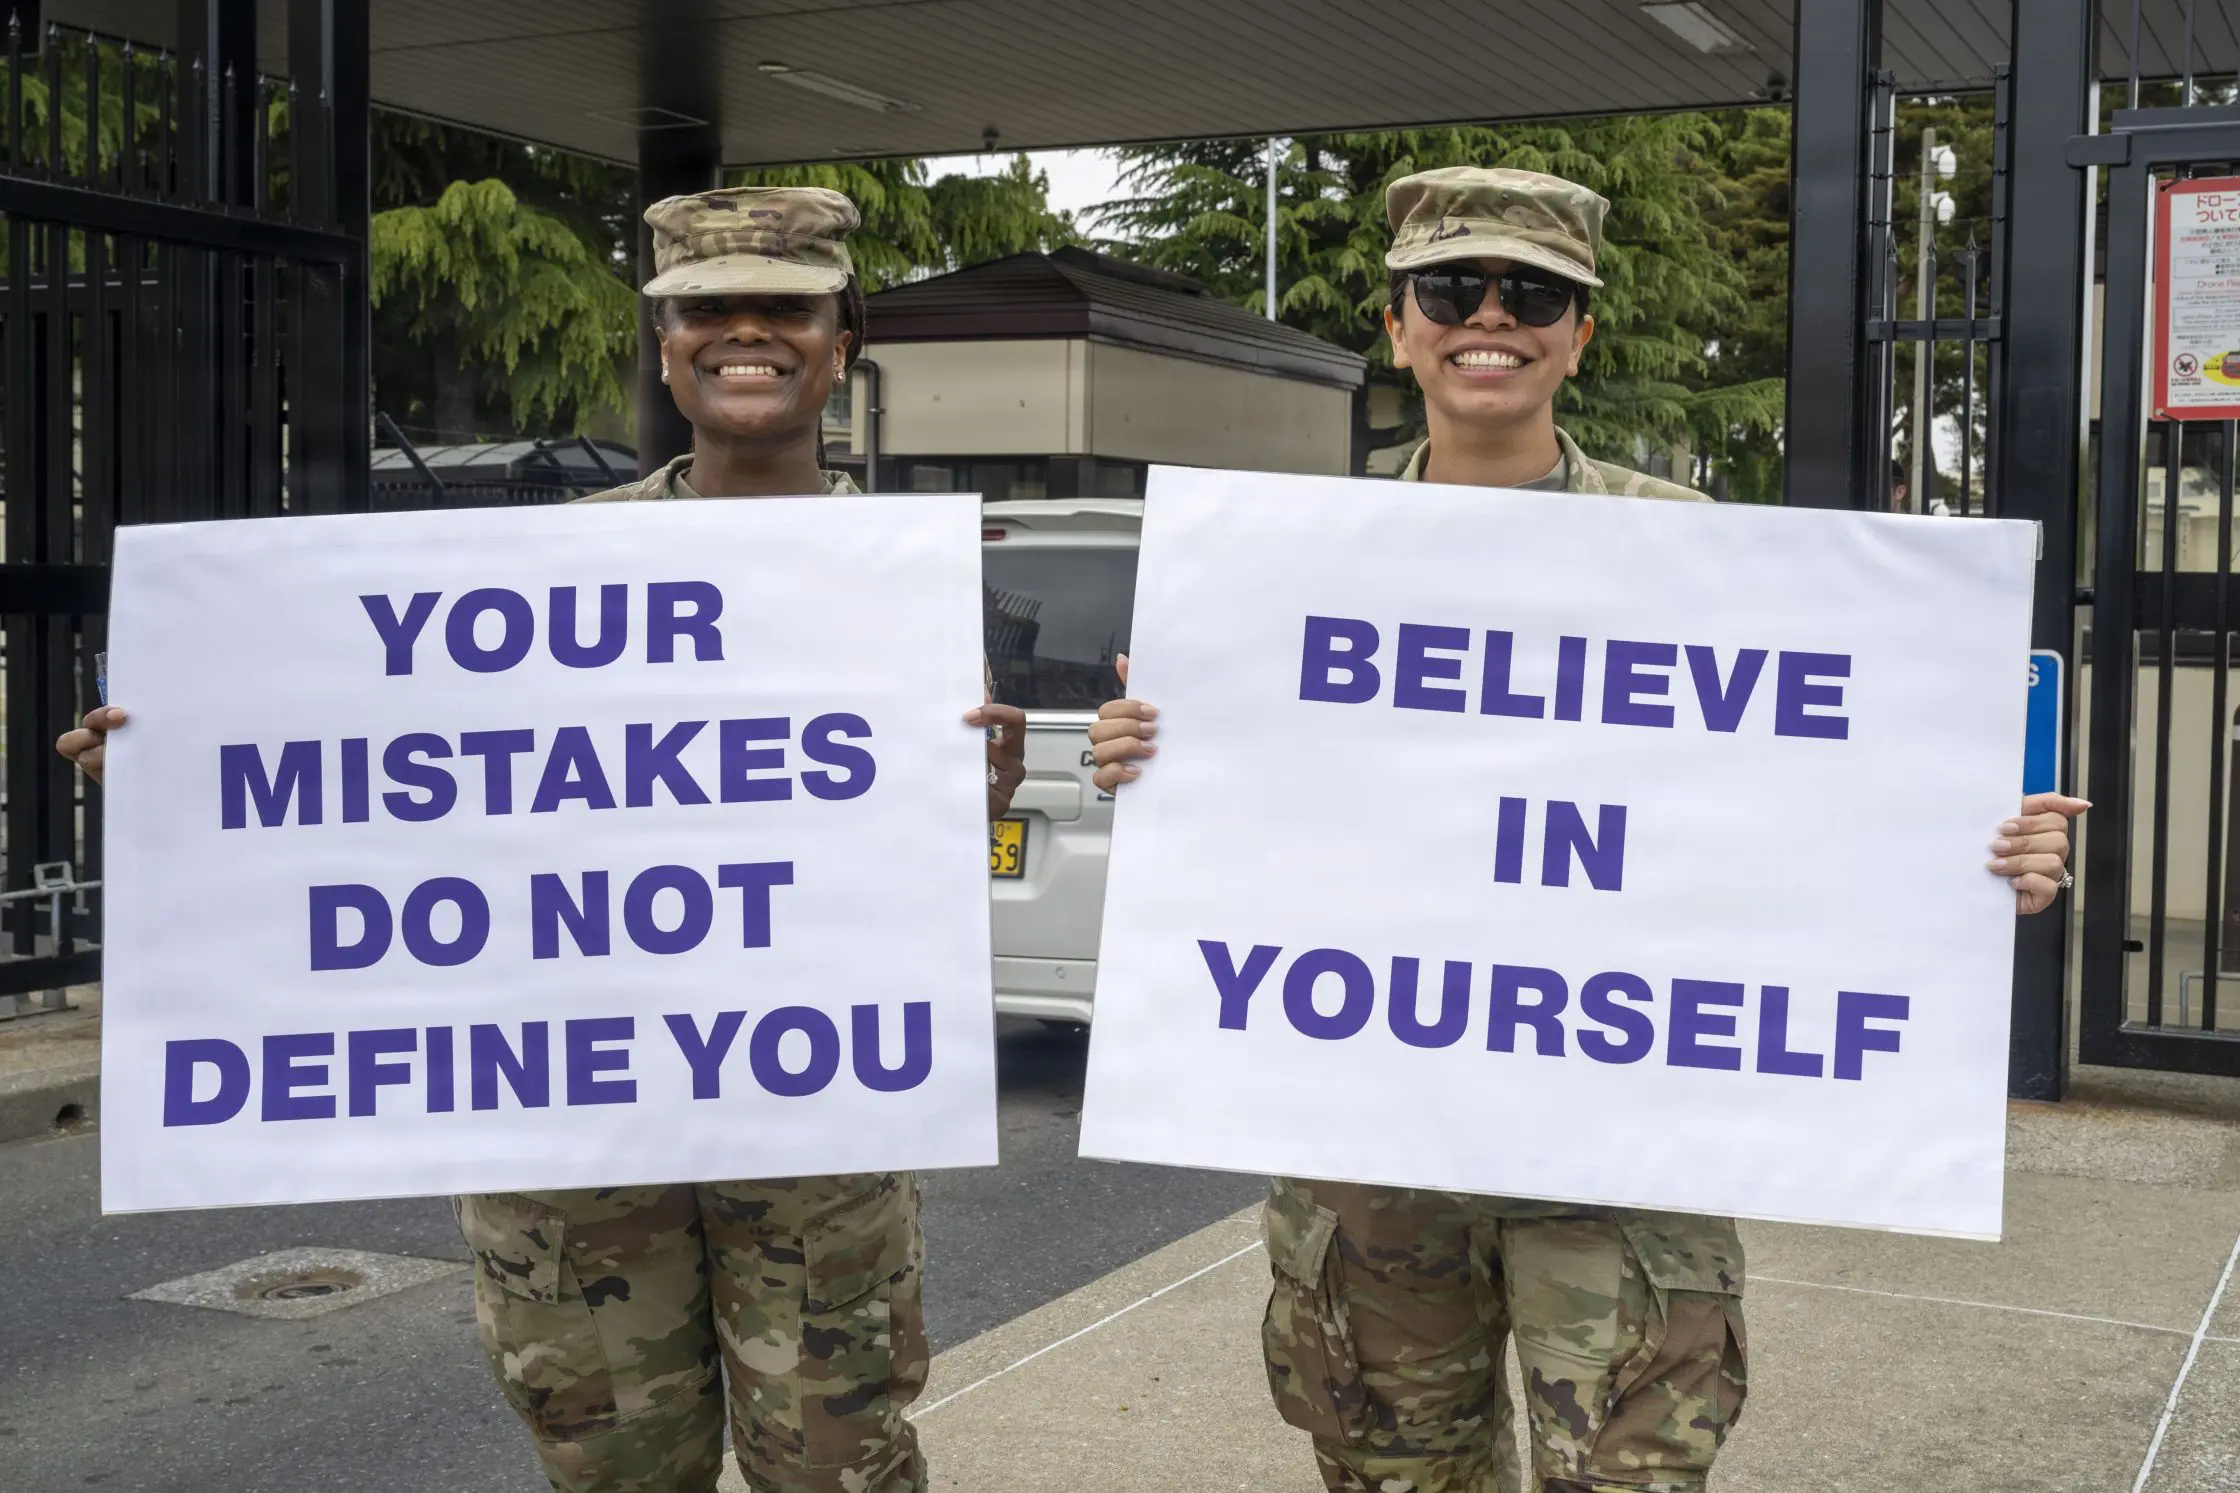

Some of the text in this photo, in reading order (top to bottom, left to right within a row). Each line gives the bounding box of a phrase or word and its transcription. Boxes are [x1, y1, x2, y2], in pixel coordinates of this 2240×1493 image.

[2196, 208, 2240, 222] ついて
[2197, 193, 2240, 208] ドロー
[361, 580, 724, 676] YOUR
[1299, 615, 1851, 740] BELIEVE
[220, 712, 876, 830] MISTAKES
[1494, 796, 1627, 892] IN
[309, 861, 794, 972] DO NOT
[163, 1001, 933, 1128] DEFINE YOU
[1199, 939, 1910, 1081] YOURSELF
